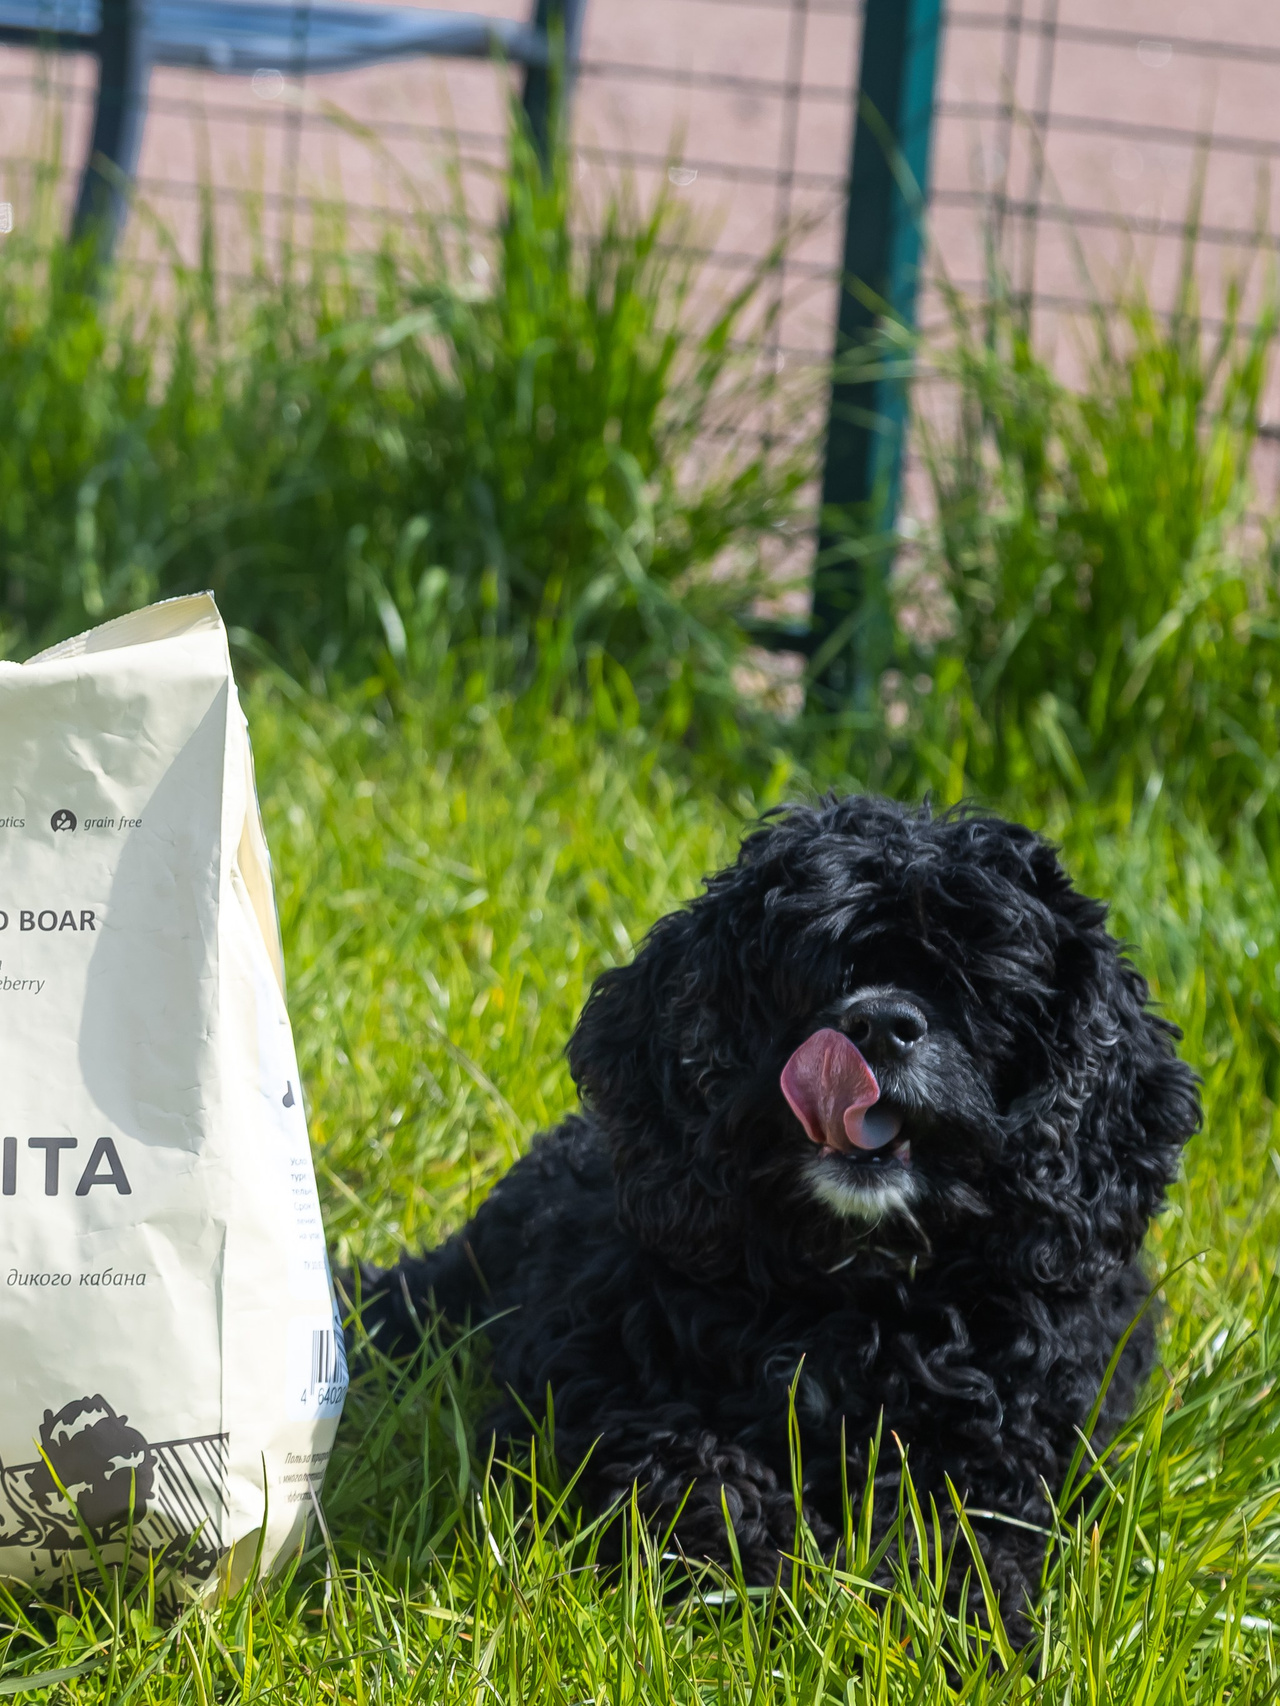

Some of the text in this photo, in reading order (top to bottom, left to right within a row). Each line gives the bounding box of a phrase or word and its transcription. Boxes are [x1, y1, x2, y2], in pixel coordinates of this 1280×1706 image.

[84, 815, 143, 831] grain free
[19, 909, 96, 932] BOAR
[6, 1268, 72, 1287] дикого
[79, 1268, 147, 1287] кабана
